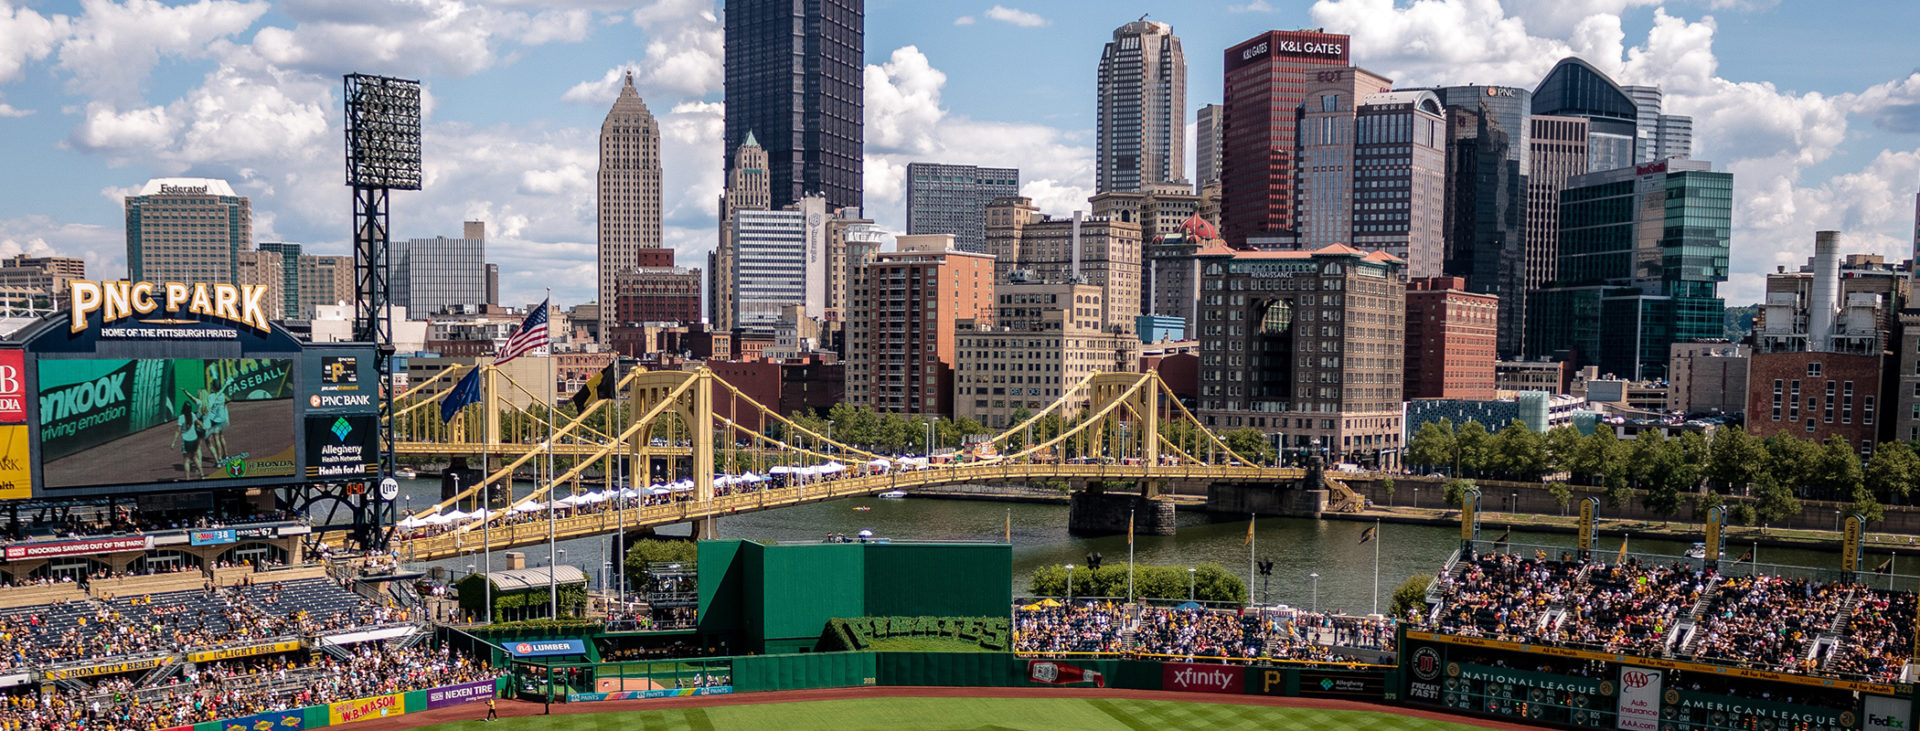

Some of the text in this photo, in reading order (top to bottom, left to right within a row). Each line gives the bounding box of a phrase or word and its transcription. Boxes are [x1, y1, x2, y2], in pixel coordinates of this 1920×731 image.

[1243, 42, 1268, 60] K&L GATES
[1280, 40, 1342, 55] K&L GATES
[1498, 88, 1516, 98] PNC
[160, 183, 208, 194] Federated
[1251, 271, 1294, 279] RENAISSANCE
[69, 279, 272, 335] PNC PARK
[101, 327, 238, 338] HOME OF THE PITTSBURGH PIRATES
[322, 394, 371, 406] PNC BANK
[78, 405, 126, 430] emotion
[321, 444, 362, 456] Allegheny
[257, 460, 294, 468] HONDA
[321, 454, 362, 463] Health Network
[318, 463, 365, 476] Health for All
[382, 483, 397, 495] Lite
[27, 546, 62, 555] KNOCKING
[62, 544, 89, 552] SAVINGS
[225, 646, 254, 657] LIGHT
[255, 644, 277, 654] BEER
[532, 643, 571, 652] LUMBER
[66, 660, 156, 678] IRON CITY BEER
[1173, 667, 1234, 690] xfinity
[1263, 670, 1281, 692] P
[1335, 680, 1364, 688] Allegheny
[1462, 671, 1596, 695] NATIONAL LEAGUE
[1623, 671, 1648, 688] AAA
[445, 687, 473, 699] NEXEN
[473, 684, 493, 694] TIRE
[1411, 681, 1441, 692] FREAKY
[1410, 688, 1439, 700] FAST!
[1631, 699, 1648, 707] Auto
[1620, 705, 1658, 716] Insurance
[1683, 699, 1766, 716] AMERICAN
[1772, 710, 1836, 726] LEAGUE
[1621, 719, 1656, 729] AAA.com
[1868, 714, 1904, 729] FedEx
